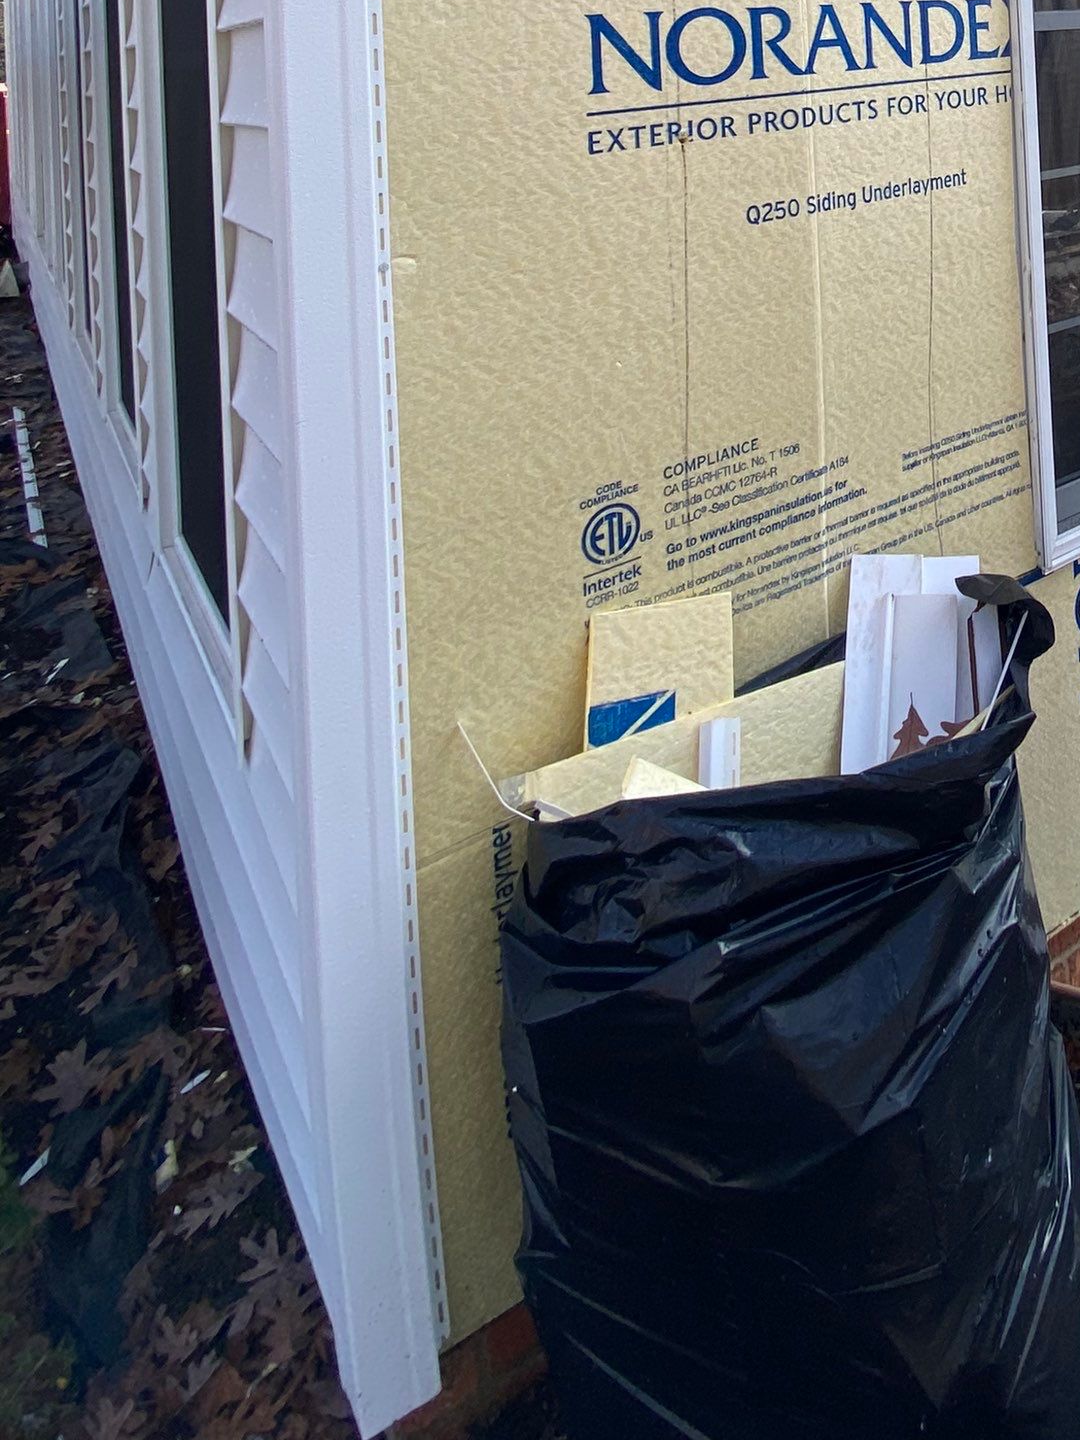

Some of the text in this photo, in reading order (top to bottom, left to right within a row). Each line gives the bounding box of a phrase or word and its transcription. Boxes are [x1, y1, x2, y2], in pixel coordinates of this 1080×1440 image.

[587, 115, 735, 156] EXTERIOR
[748, 99, 878, 135] PRODUCTS
[887, 92, 928, 119] FOR
[934, 86, 988, 112] YOUR
[747, 167, 968, 227] Q250 Siding Underlayment
[663, 438, 759, 480] COMPLIANCE
[663, 484, 680, 498] CA
[751, 456, 768, 469] No.
[769, 450, 776, 461] T
[579, 483, 640, 511] COMPLIANCE
[596, 480, 622, 496] CODE
[664, 466, 778, 515] Canada CCMC 12764-R
[665, 465, 829, 531] UL Classification Certificate
[640, 530, 654, 542] US
[666, 543, 683, 555] Go
[686, 536, 697, 549] to
[834, 479, 849, 492] for
[667, 487, 868, 571] the most current compliance information.
[582, 565, 643, 597] Intertek
[654, 583, 686, 601] product
[745, 555, 753, 567] A
[753, 543, 790, 566] protective
